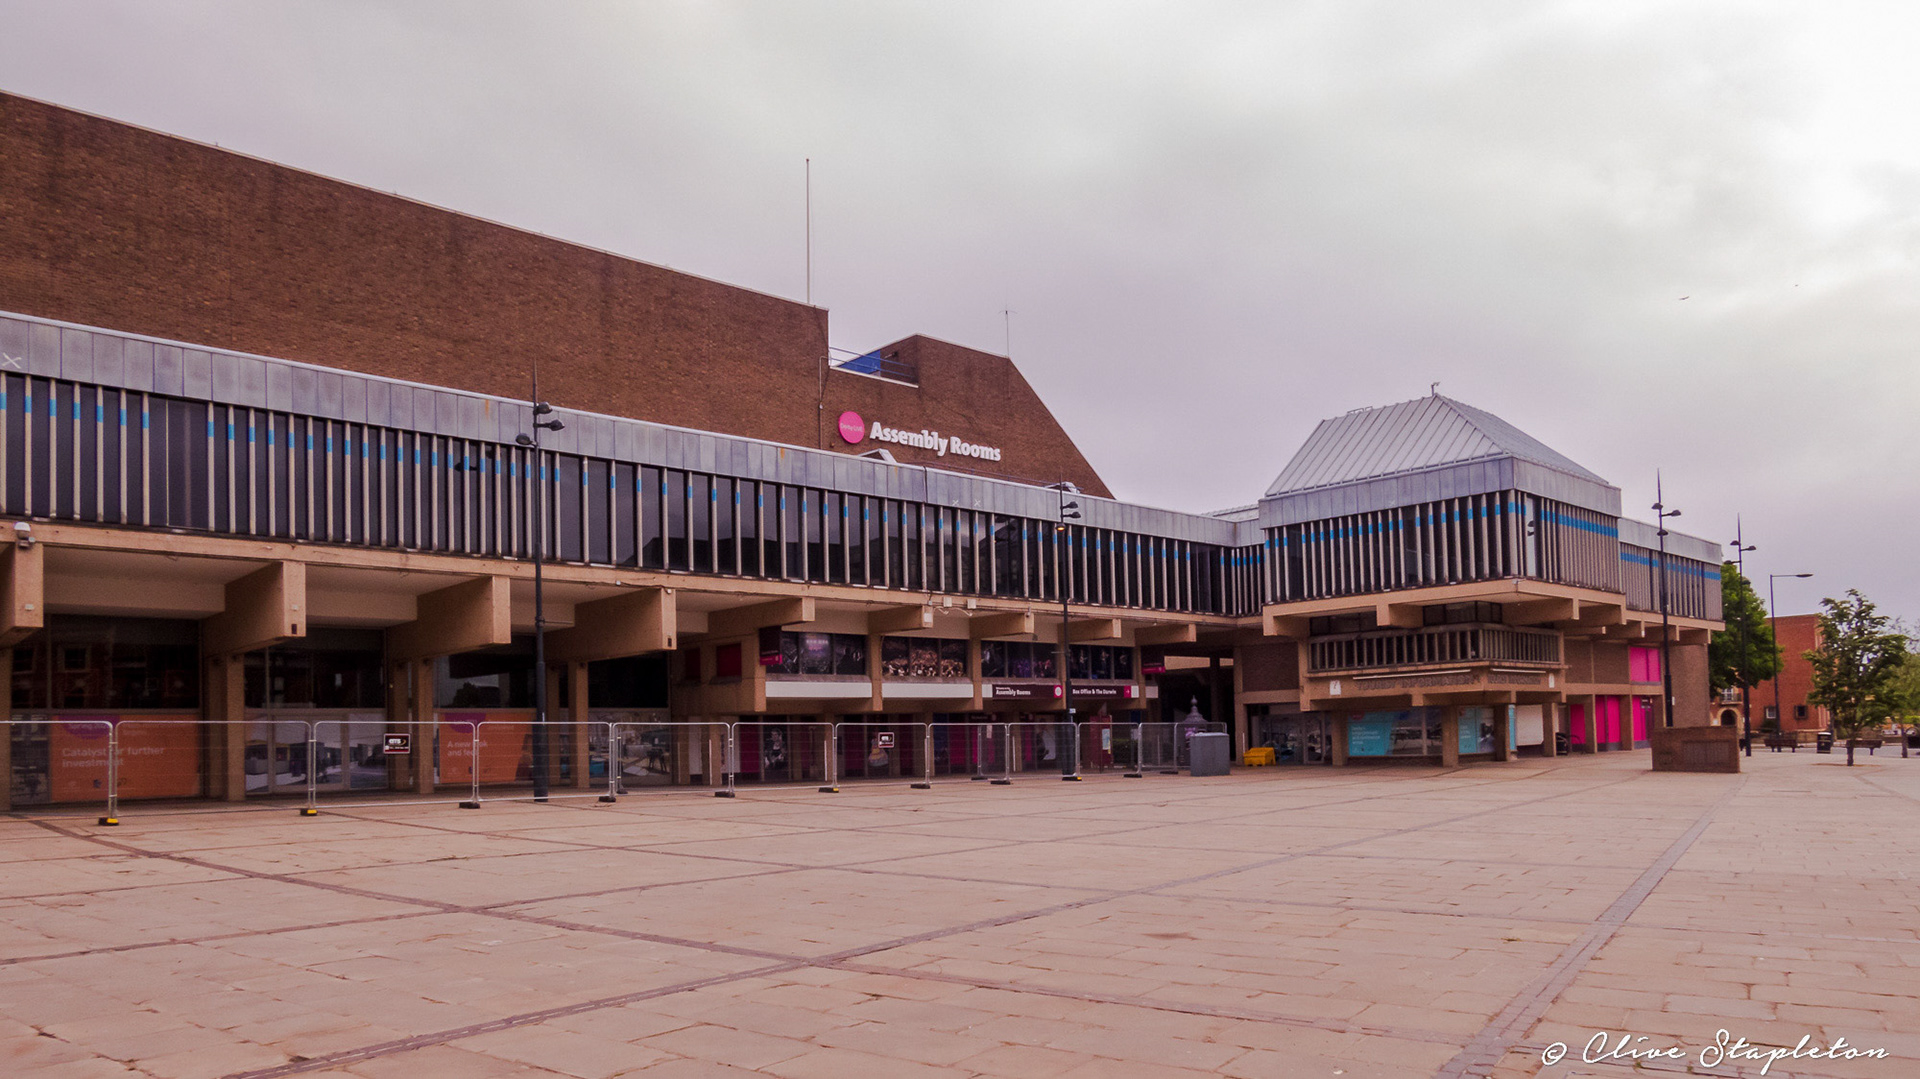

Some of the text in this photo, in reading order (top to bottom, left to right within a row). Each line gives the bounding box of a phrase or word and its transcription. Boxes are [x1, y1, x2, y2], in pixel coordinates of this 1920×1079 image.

[869, 421, 1002, 462] Assembly Rooms
[996, 689, 1016, 697] Assembly
[447, 740, 454, 748] A
[62, 747, 107, 758] Catalyst
[127, 746, 165, 756] further
[447, 749, 462, 757] and
